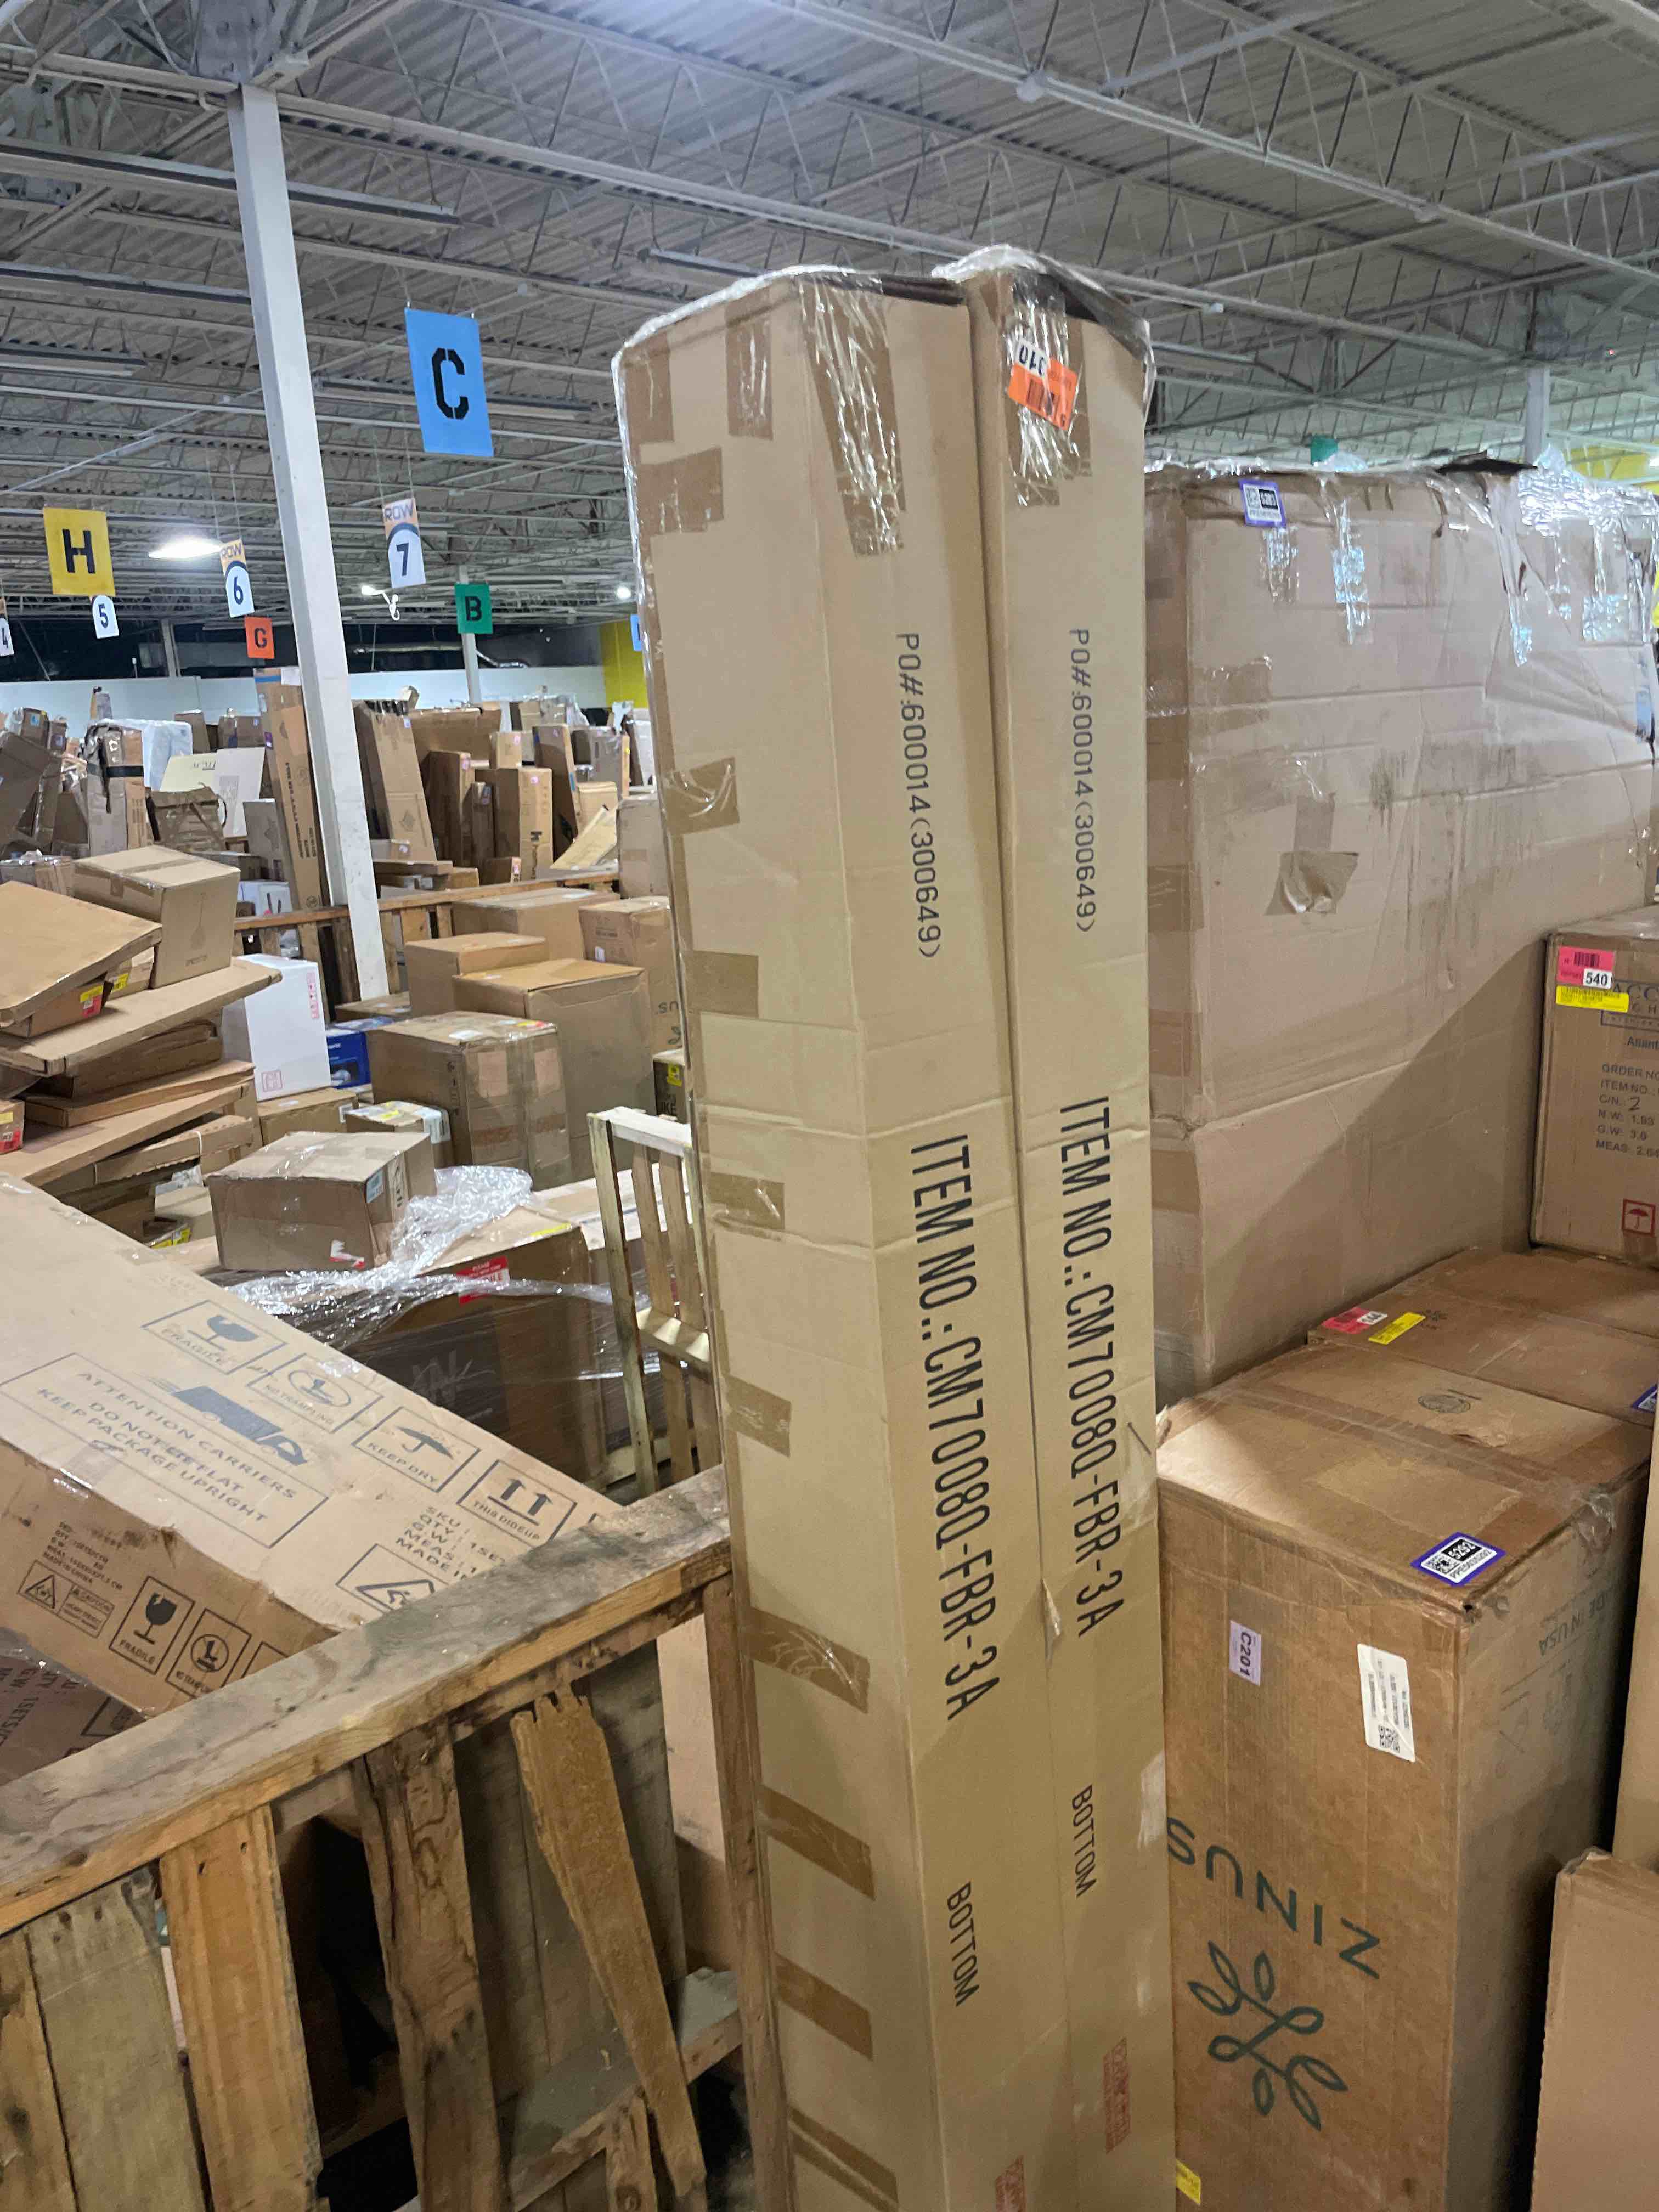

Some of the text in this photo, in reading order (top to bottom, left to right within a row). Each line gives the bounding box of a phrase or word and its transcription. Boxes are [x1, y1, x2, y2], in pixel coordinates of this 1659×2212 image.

[431, 348, 470, 420] C
[385, 503, 414, 522] ROW
[61, 529, 96, 574] H
[220, 543, 242, 561] ROW
[396, 544, 408, 577] 7
[233, 577, 245, 605] 6
[465, 597, 482, 622] B
[99, 603, 109, 628] 5
[2, 627, 8, 649] 4
[253, 629, 267, 648] G
[1585, 972, 1608, 986] 540
[1602, 1063, 1643, 1077] ORDER
[1059, 1096, 1111, 1199] ITEM
[910, 1134, 974, 1244] ITEM
[89, 1402, 119, 1422] DO
[37, 1387, 268, 1522] KEEP PACKAGE UPRIGHT
[77, 1372, 298, 1500] ATTENTION CARRIERS
[368, 1443, 438, 1485] KEEP DRY
[1238, 1631, 1253, 1678] C201
[1071, 1784, 1097, 1897] BOTTOM
[1166, 1816, 1380, 1980] ZINUS
[946, 1881, 980, 2007] BOTTOM
